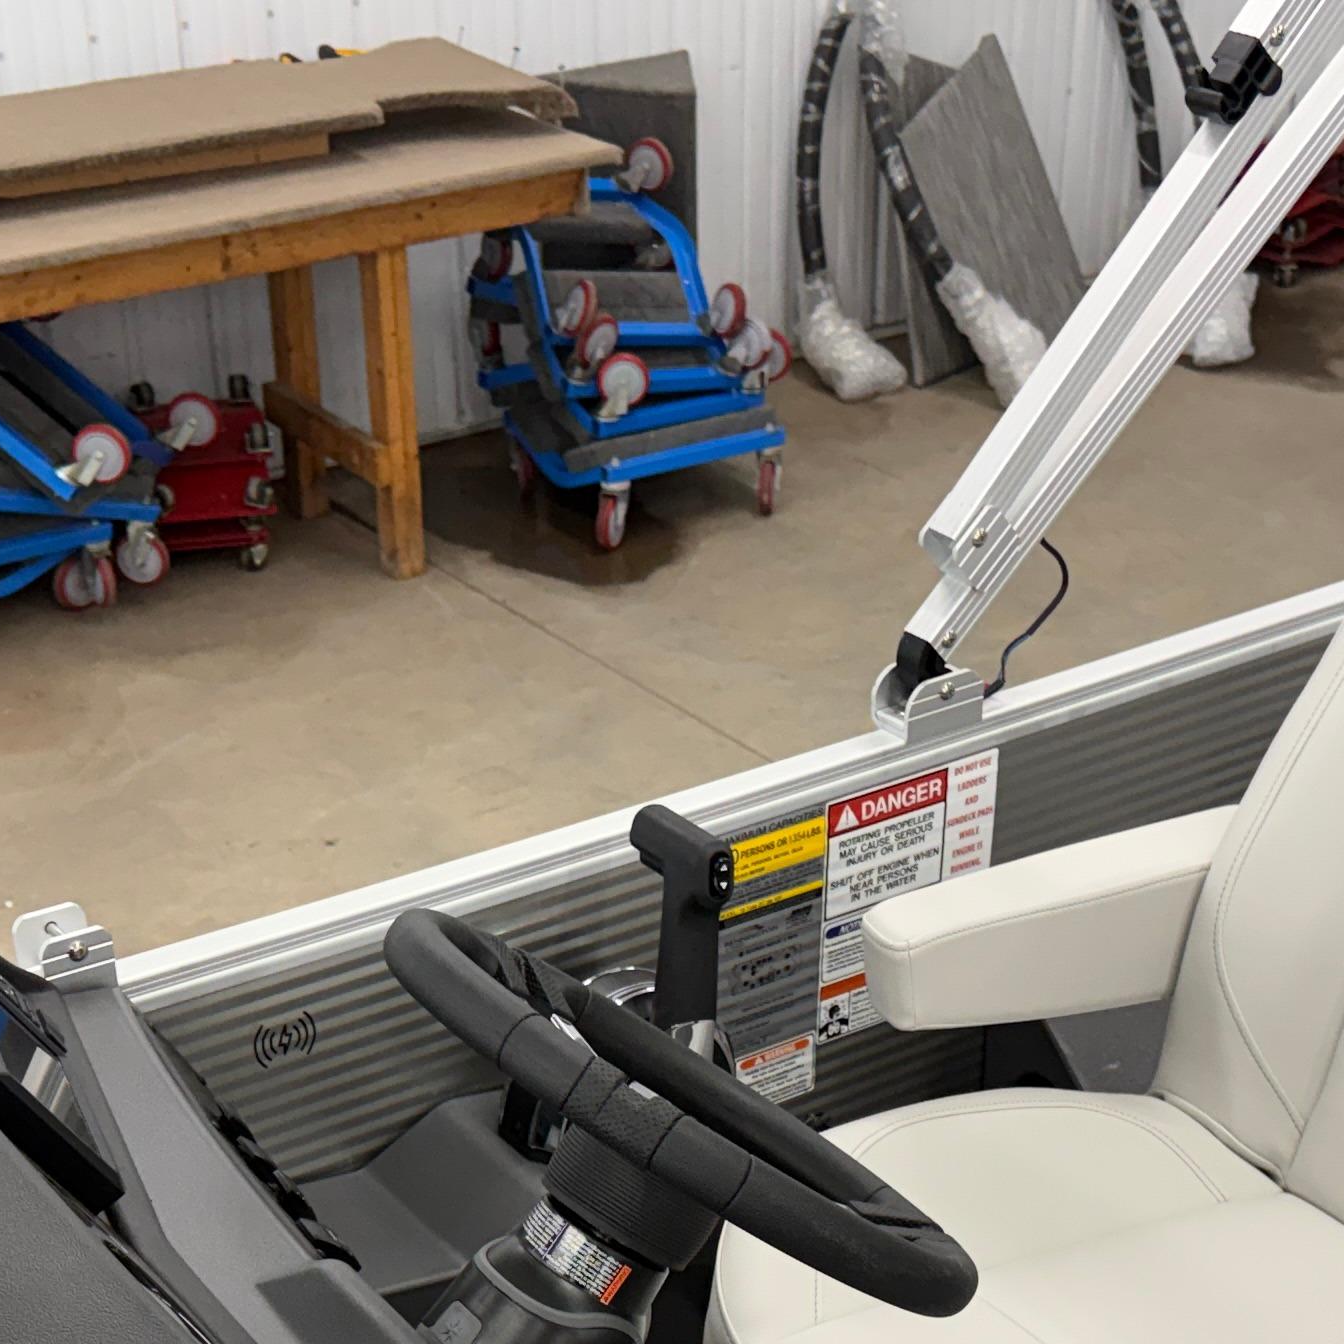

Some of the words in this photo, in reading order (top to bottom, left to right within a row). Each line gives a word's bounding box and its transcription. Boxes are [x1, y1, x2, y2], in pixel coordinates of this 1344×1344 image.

[965, 760, 978, 773] NOT
[957, 775, 987, 792] LADDERS
[861, 777, 942, 821] DANGER
[964, 795, 979, 806] AND
[768, 807, 824, 832] CAPACITIES
[839, 828, 881, 849] ROTATING
[884, 811, 935, 835] PROPELLER
[740, 840, 775, 859] PERSONS
[776, 837, 787, 848] OR
[839, 847, 857, 859] MAY
[860, 836, 891, 852] CAUSE
[894, 822, 933, 841] SERIOUS
[846, 851, 877, 867] INJURY
[880, 845, 894, 856] OR
[897, 835, 926, 851] DEATH
[830, 876, 854, 890] SHUT
[857, 868, 874, 880] OFF
[877, 856, 910, 874] ENGINE
[913, 847, 940, 862] WHEN
[849, 879, 874, 894] NEAR
[877, 864, 919, 883] PERSONS
[851, 893, 861, 902] IN
[864, 885, 883, 898] THE
[886, 874, 916, 890] WATER
